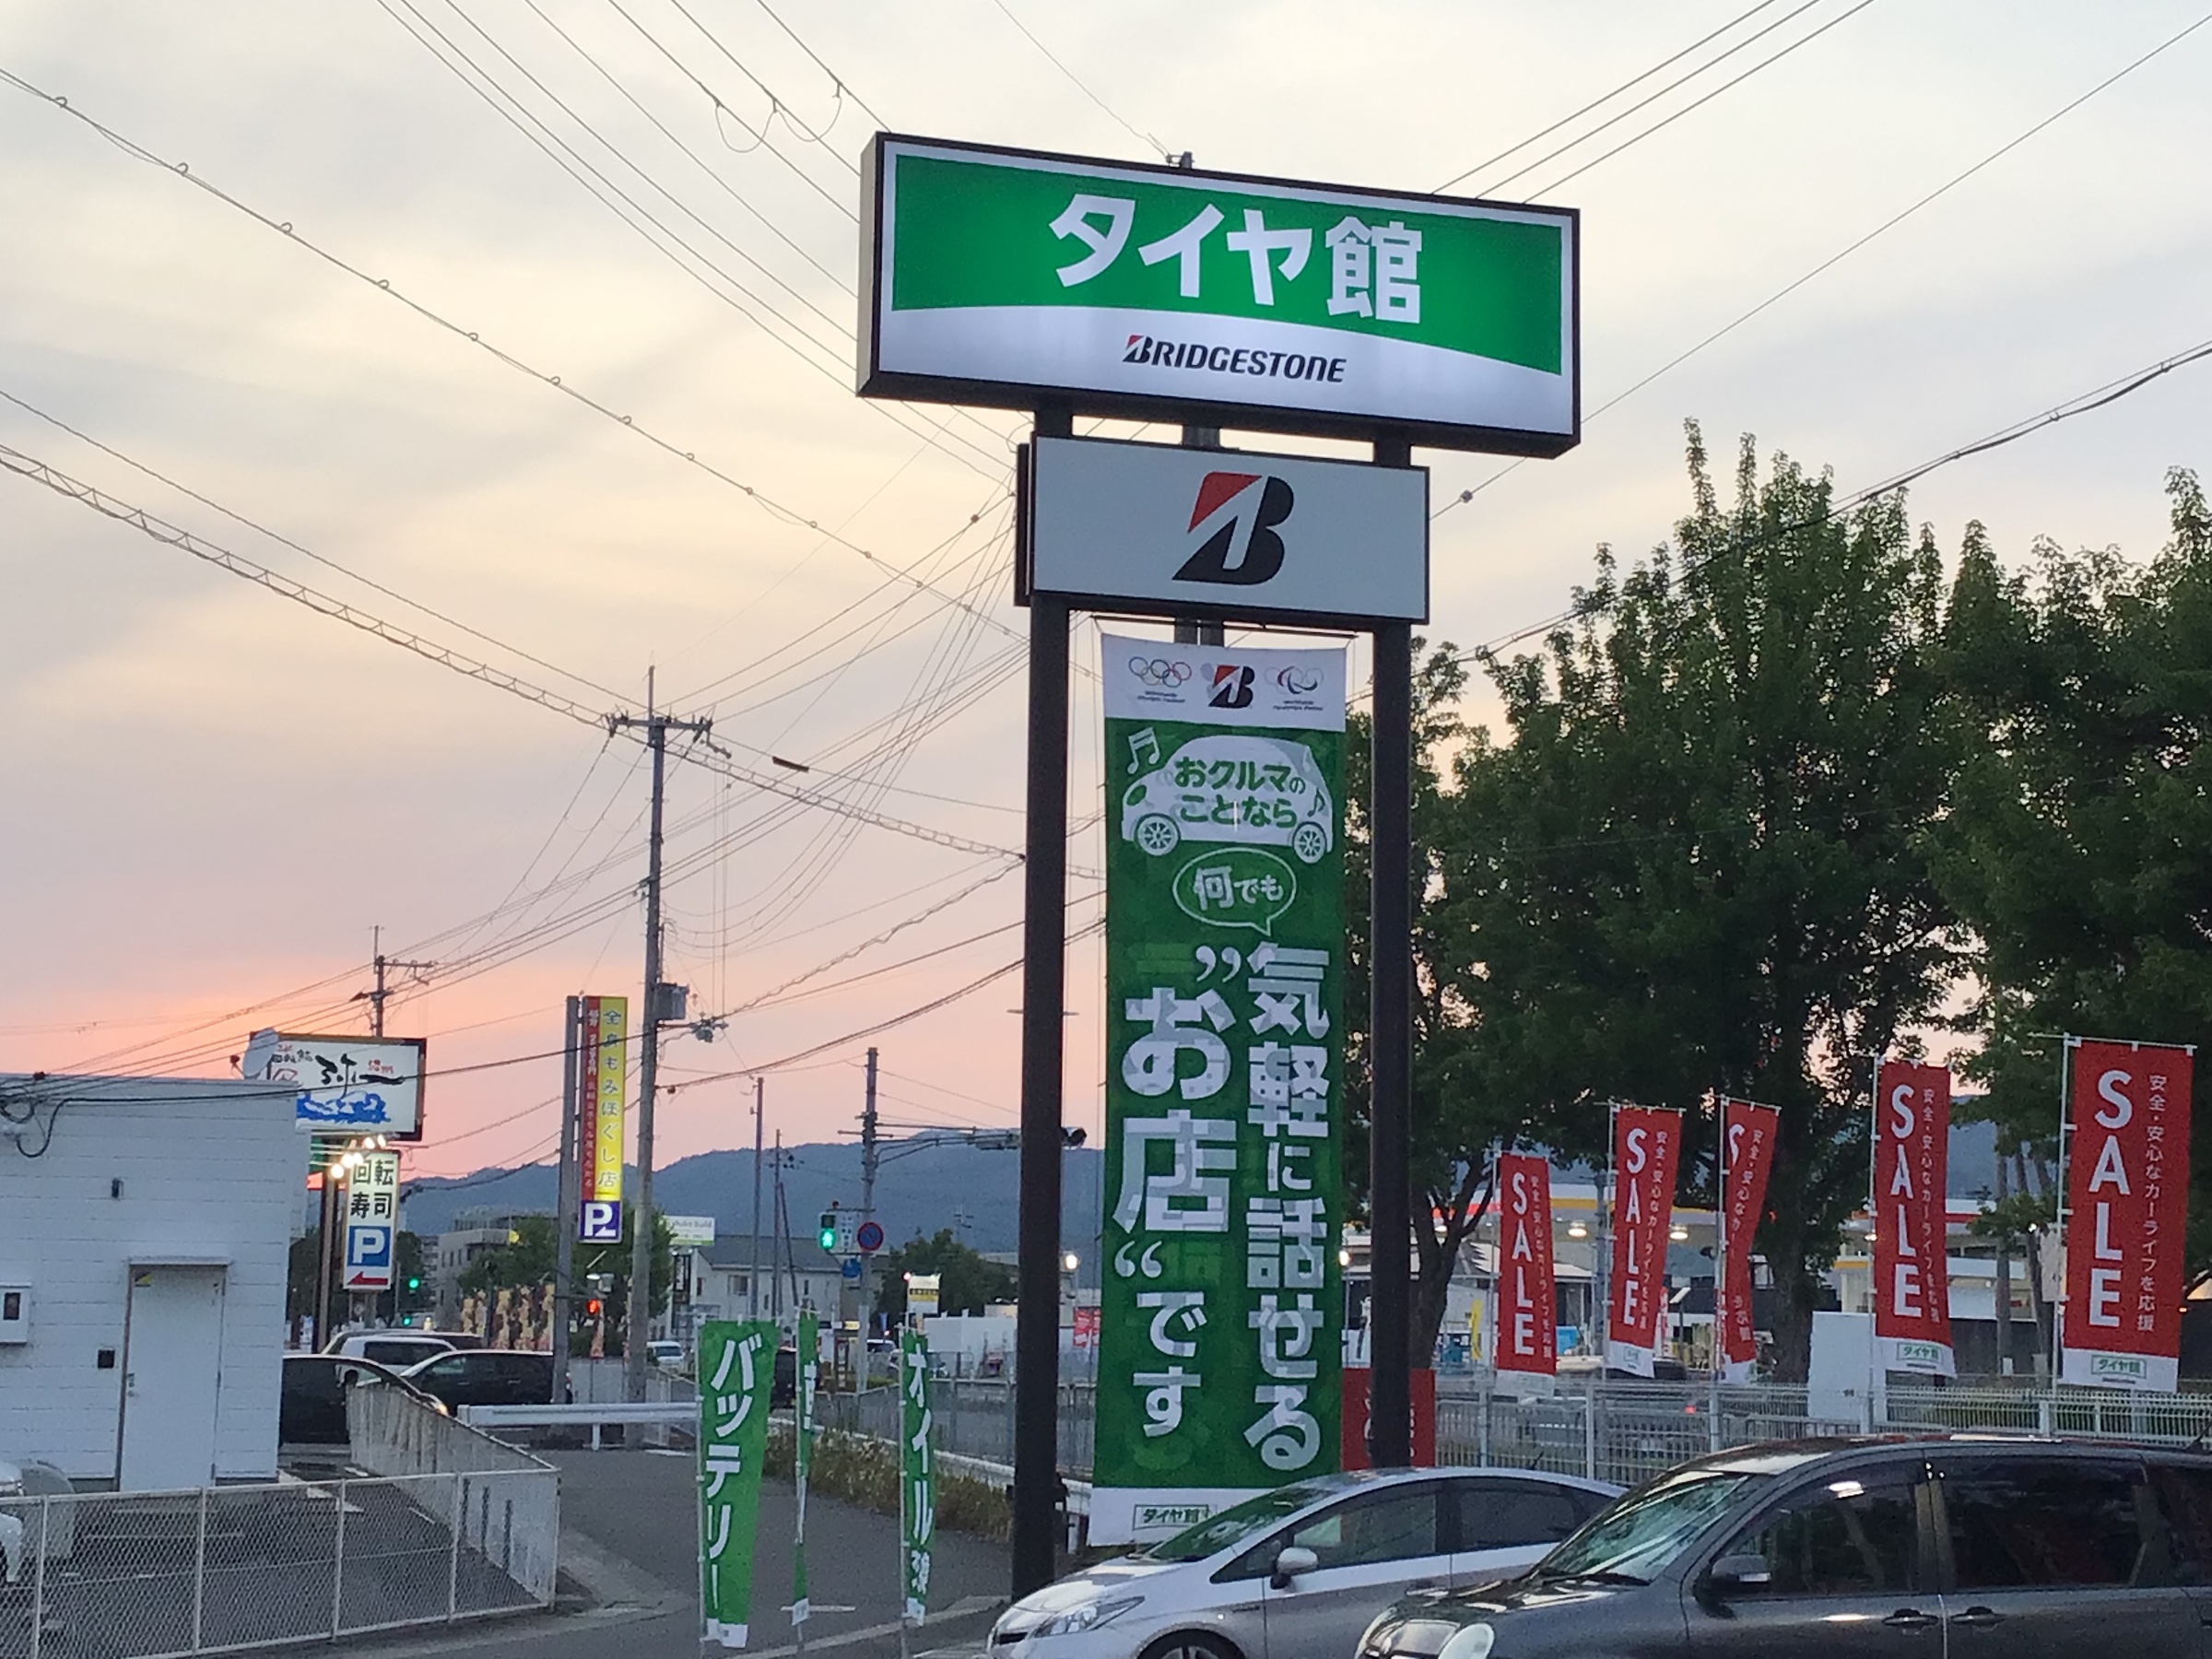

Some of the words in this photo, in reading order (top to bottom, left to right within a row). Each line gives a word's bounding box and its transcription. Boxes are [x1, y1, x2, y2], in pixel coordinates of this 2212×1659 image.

[1048, 192, 1422, 325] タイヤ館
[1122, 334, 1347, 382] BRIDGESTONE
[1174, 756, 1306, 794] おクルマの
[1180, 794, 1298, 829] ことなら
[1193, 865, 1285, 912] 何でも
[353, 1159, 394, 1185] 回転
[597, 1009, 621, 1188] 全身もみほぐし店
[350, 1192, 393, 1219] 寿司
[352, 1229, 385, 1264] P
[1243, 941, 1331, 1472] 気軽に話せる
[1512, 1171, 1535, 1356] SALE
[1622, 1127, 1648, 1326] SALE
[1890, 1084, 1922, 1318] SALE
[2088, 1069, 2134, 1327] SALE
[2136, 1074, 2168, 1332] 安全・安心なカーライフを応援
[705, 1332, 763, 1610] バッテリー
